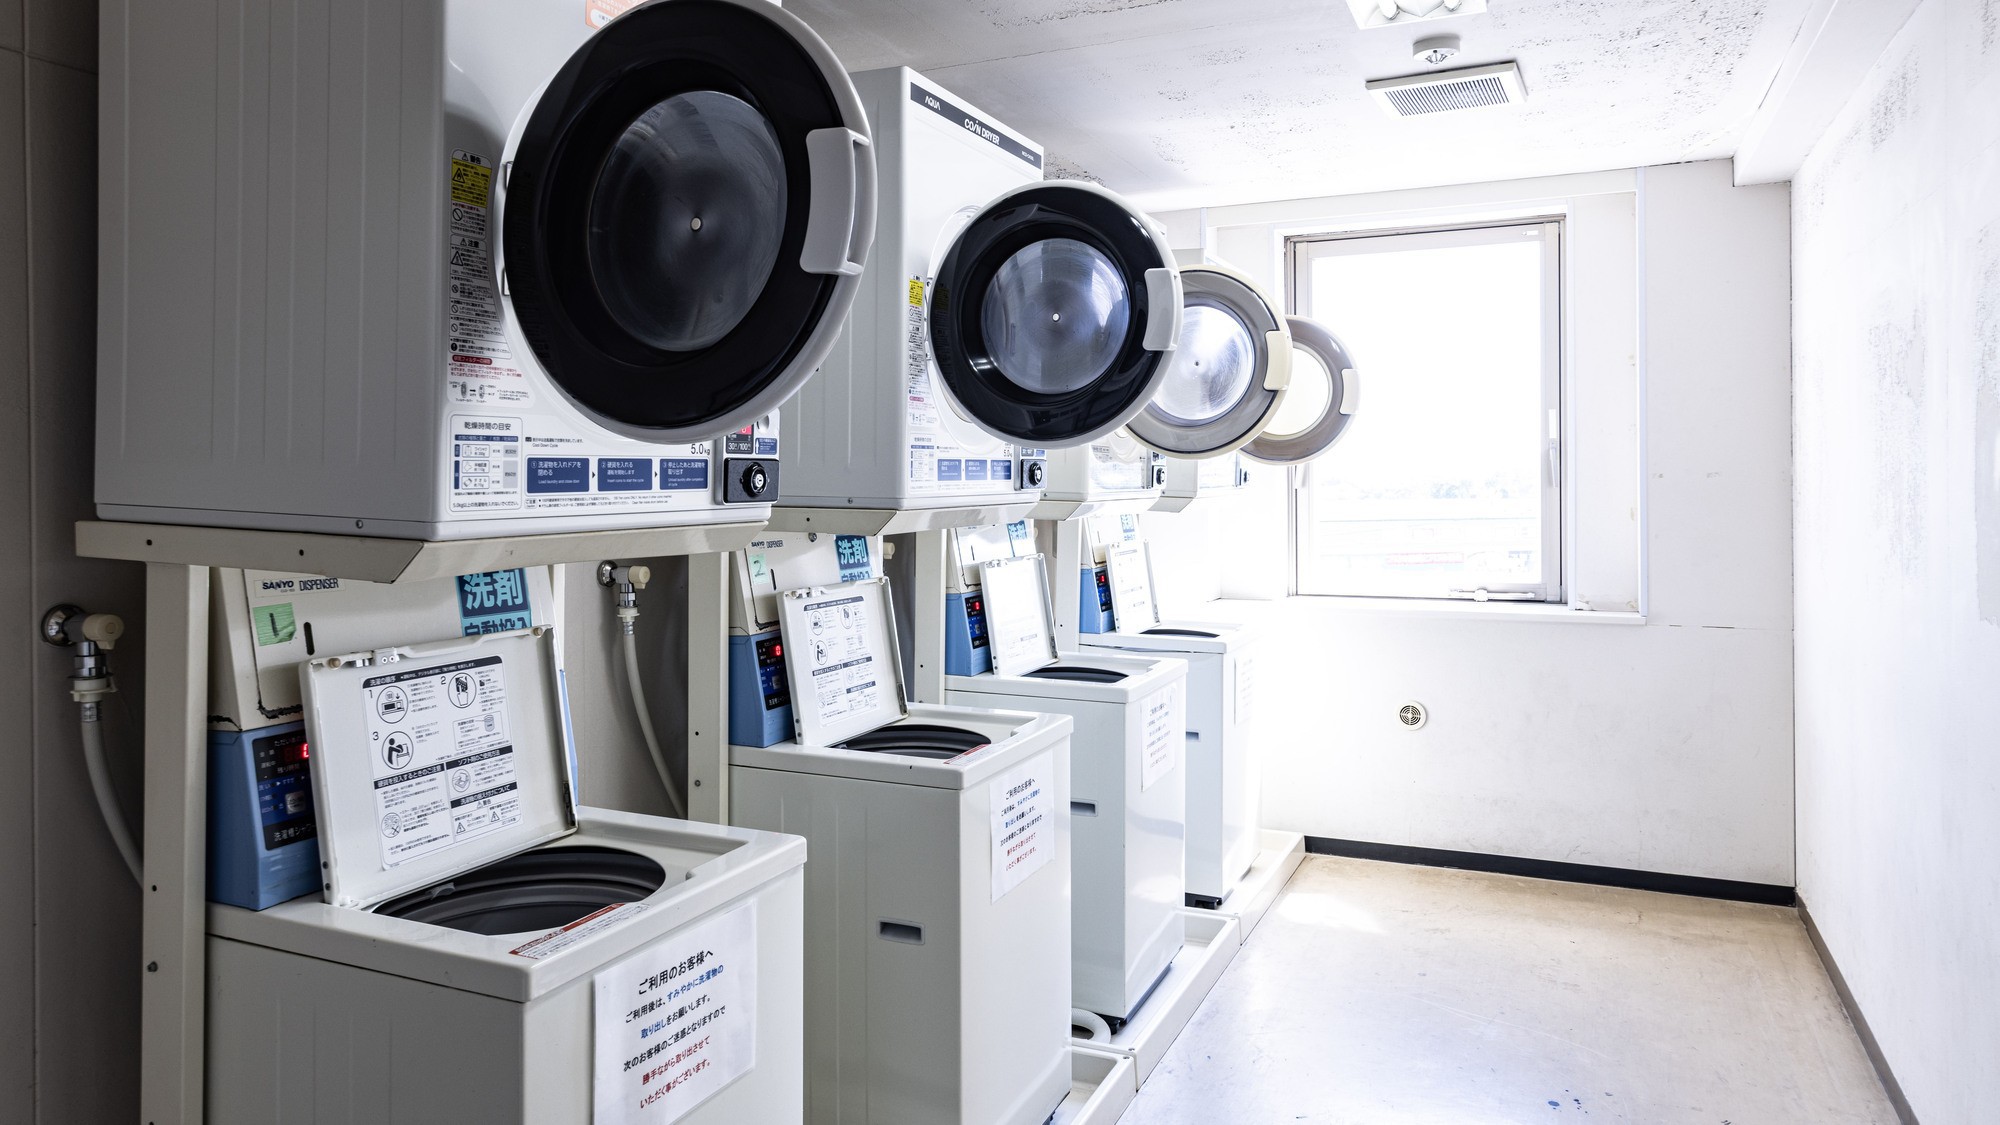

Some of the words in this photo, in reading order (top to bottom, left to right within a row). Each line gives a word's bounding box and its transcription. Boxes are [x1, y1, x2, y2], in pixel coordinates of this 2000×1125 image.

[924, 96, 940, 110] AQUA
[964, 118, 981, 135] COIN
[981, 128, 1000, 145] DRYER
[464, 421, 511, 430] 乾燥時間の目安
[690, 443, 710, 455] 5.0kg
[838, 538, 867, 565] 洗剤
[754, 559, 765, 577] 2
[262, 580, 294, 590] SANYO
[299, 577, 339, 591] DISPENSER
[463, 570, 524, 610] 洗剤
[368, 690, 373, 698] 1
[440, 676, 447, 685] 2
[372, 731, 379, 741] 3
[639, 950, 713, 994] ご利用のお客様へ
[626, 965, 724, 1023] ご利用後は、すみやかに洗濯物の
[641, 994, 710, 1038] 取り出しをお願いします。
[623, 1005, 726, 1072] 次のお客様のご迷惑となりますので
[642, 1035, 710, 1085] 勝手ながら取り出させて
[640, 1059, 710, 1109] いただく事がございます。
